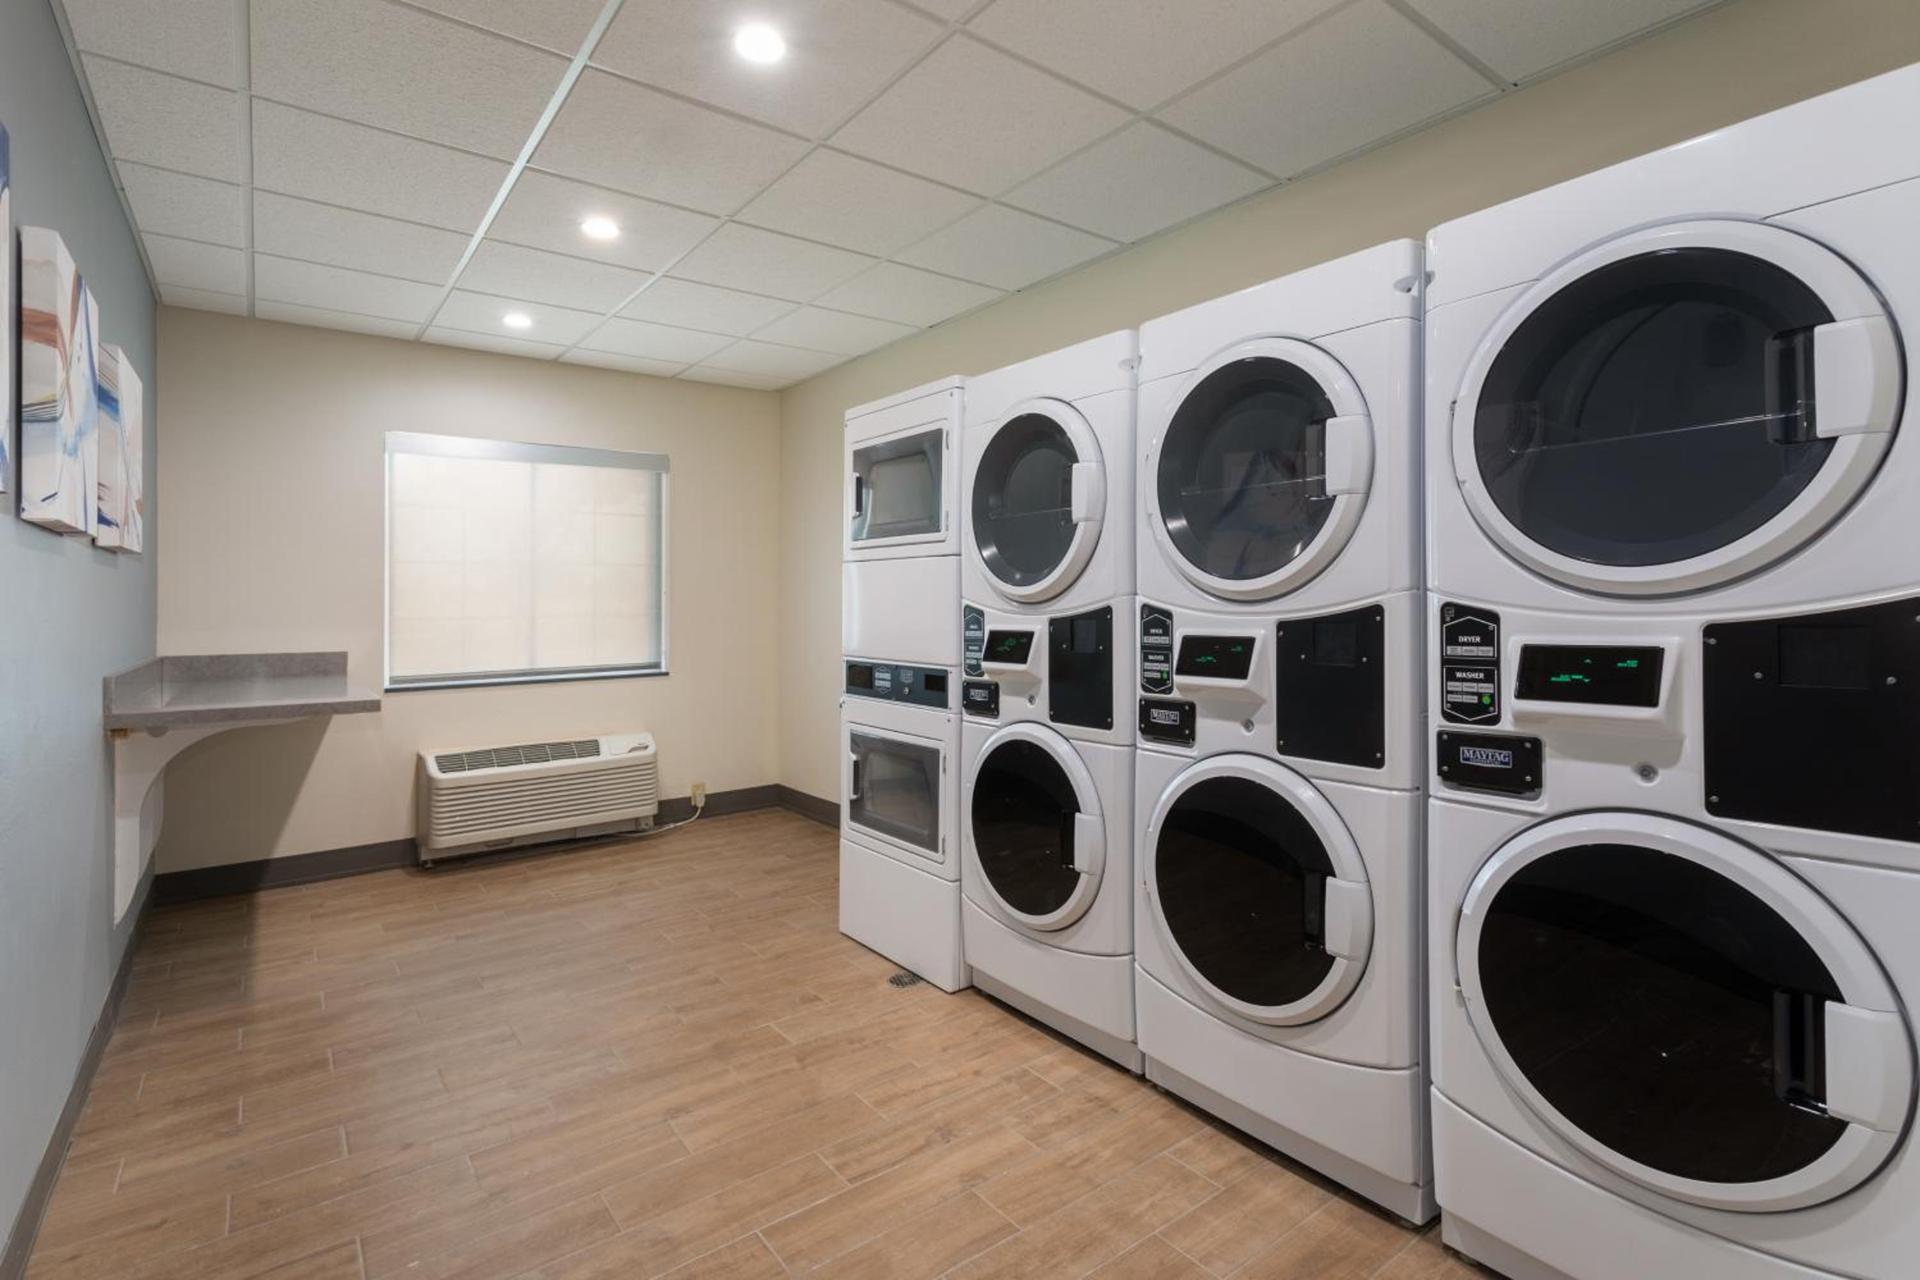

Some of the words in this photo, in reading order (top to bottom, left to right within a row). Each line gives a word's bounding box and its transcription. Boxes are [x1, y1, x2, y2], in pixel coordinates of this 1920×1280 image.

[1458, 635, 1481, 643] DRYER
[1455, 671, 1485, 680] WASHER
[1463, 749, 1510, 762] MAYTAG
